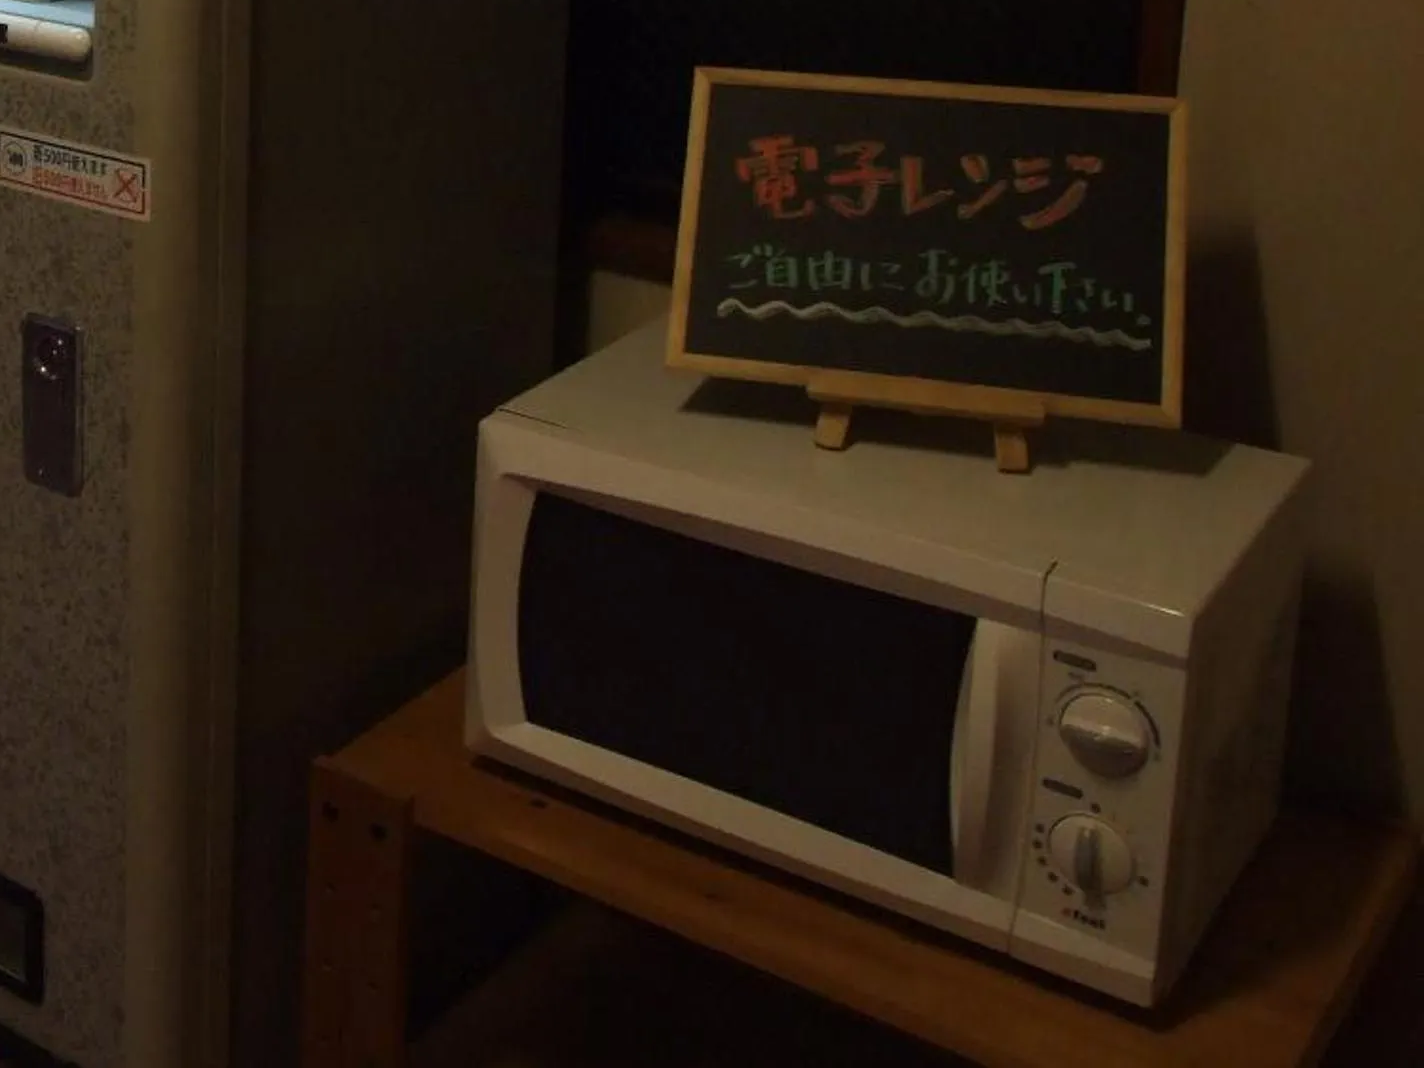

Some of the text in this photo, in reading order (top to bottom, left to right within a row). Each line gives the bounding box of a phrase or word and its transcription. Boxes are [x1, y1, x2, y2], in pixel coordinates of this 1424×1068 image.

[738, 133, 1104, 230] 電子レンジ
